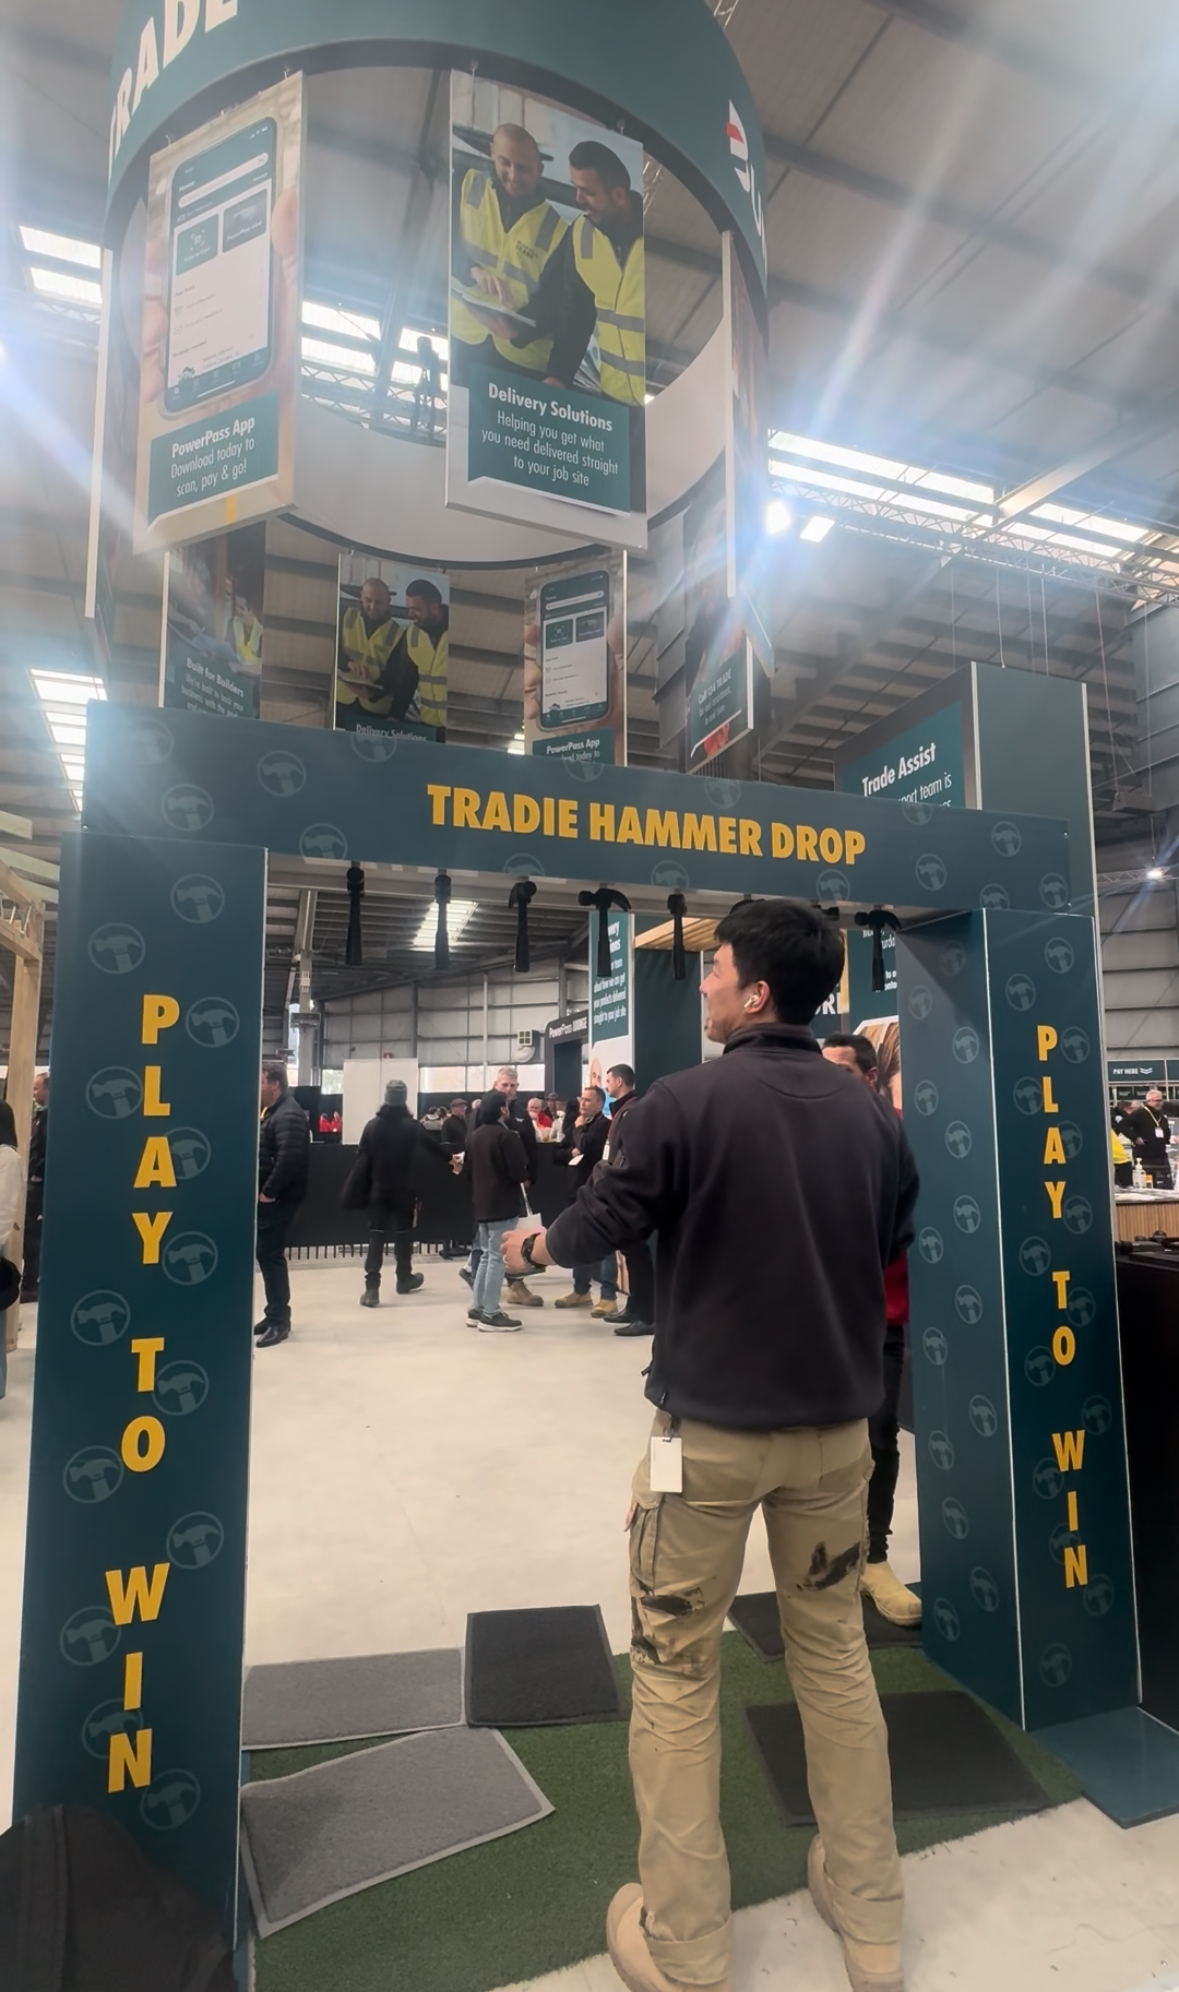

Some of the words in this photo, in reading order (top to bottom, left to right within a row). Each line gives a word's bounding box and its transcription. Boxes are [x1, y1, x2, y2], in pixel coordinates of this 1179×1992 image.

[489, 382, 547, 416] Delivery
[551, 401, 613, 431] Solutions
[172, 427, 230, 459] PowerPass
[232, 417, 255, 437] App
[481, 429, 501, 443] you
[505, 435, 530, 452] need
[533, 440, 579, 465] delivered
[582, 455, 619, 476] straight
[497, 410, 536, 436] Helping
[539, 425, 558, 439] you
[561, 431, 577, 446] get
[580, 435, 605, 452] what
[171, 448, 214, 478] Download
[216, 441, 242, 462] today
[245, 438, 255, 452] to
[176, 480, 199, 497] scan,
[201, 472, 218, 491] pay
[221, 464, 229, 480] &
[232, 457, 247, 480] go!
[513, 455, 524, 469] to
[527, 460, 550, 476] your
[552, 465, 569, 482] job
[572, 471, 590, 487] site
[546, 741, 585, 755] PowerPass
[585, 739, 600, 749] App
[862, 765, 896, 797] Trade
[898, 742, 937, 780] Assist
[919, 779, 942, 800] team
[944, 771, 952, 789] is
[427, 784, 578, 838] TRADIE
[590, 802, 763, 857] HAMMER
[771, 822, 866, 865] DROP
[549, 1023, 573, 1038] PowerPass
[132, 994, 180, 1265] PLAY
[1037, 1025, 1067, 1219] PLAY
[1052, 1270, 1076, 1366] TO
[120, 1336, 166, 1472] TO
[1052, 1429, 1088, 1588] WIN
[105, 1562, 170, 1793] WIN
